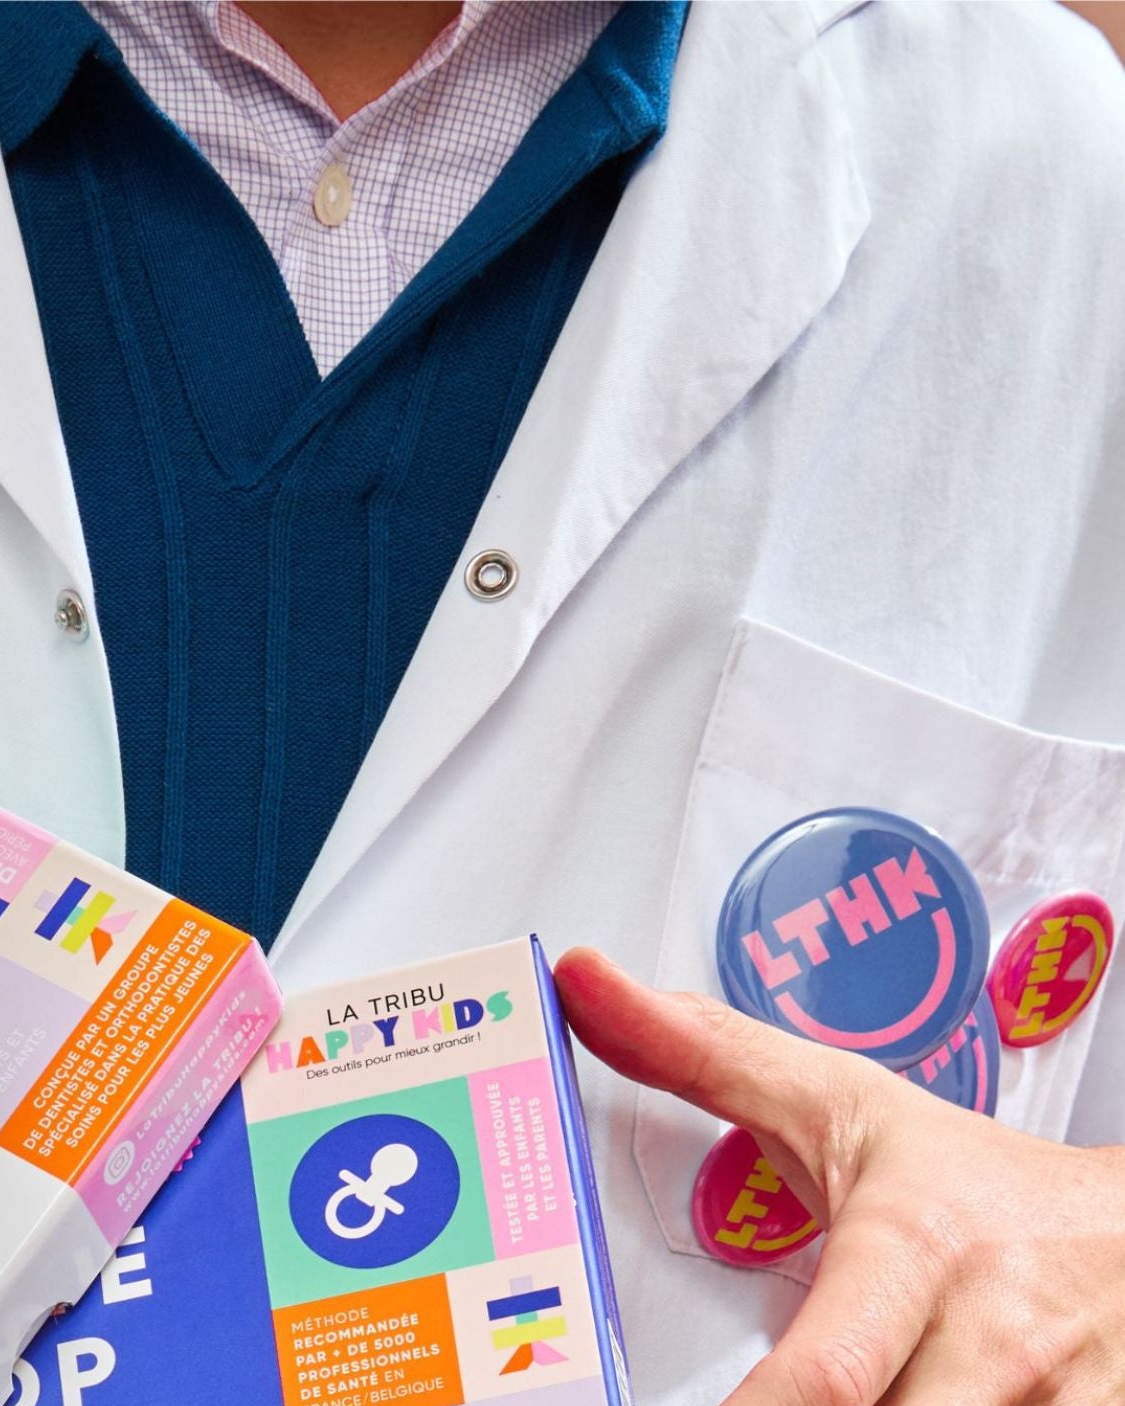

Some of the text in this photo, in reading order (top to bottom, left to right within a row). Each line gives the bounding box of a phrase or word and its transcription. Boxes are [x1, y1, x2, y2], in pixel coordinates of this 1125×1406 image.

[741, 846, 942, 991] LTHK
[33, 944, 160, 1108] CONÇUE PAR UN GROUPE
[326, 983, 446, 1026] LA TRIBU
[1008, 916, 1071, 1040] LTHK
[7, 1028, 25, 1048] ET
[23, 920, 197, 1150] DE DENTISTES ET ORTHODONTISTES
[38, 928, 212, 1157] SPÉCIALISÉ DANS LA PRATIQUE DES
[66, 953, 214, 1148] SOINS POUR LES PLUS JEUNES
[263, 990, 513, 1074] HAPPY KIDS
[305, 1034, 475, 1081] Des outils pour mieux grandir
[116, 1102, 193, 1207] REJOIGNEZ
[192, 1077, 212, 1099] LA
[212, 1020, 253, 1072] TRIBU
[486, 1081, 522, 1245] TESTÉE ET APPROUVÉE
[508, 1096, 540, 1222] PAR LES ENFANTS
[529, 1097, 557, 1212] ET LES PARENTS
[715, 1157, 783, 1249] LTH
[291, 1307, 370, 1333] MÉTHODE
[294, 1313, 420, 1350] RECOMMANDÉE
[295, 1331, 416, 1367] PAR + DE 5000
[298, 1344, 441, 1384] PROFESSIONNELS
[300, 1369, 405, 1400] DE SANTÉ EN
